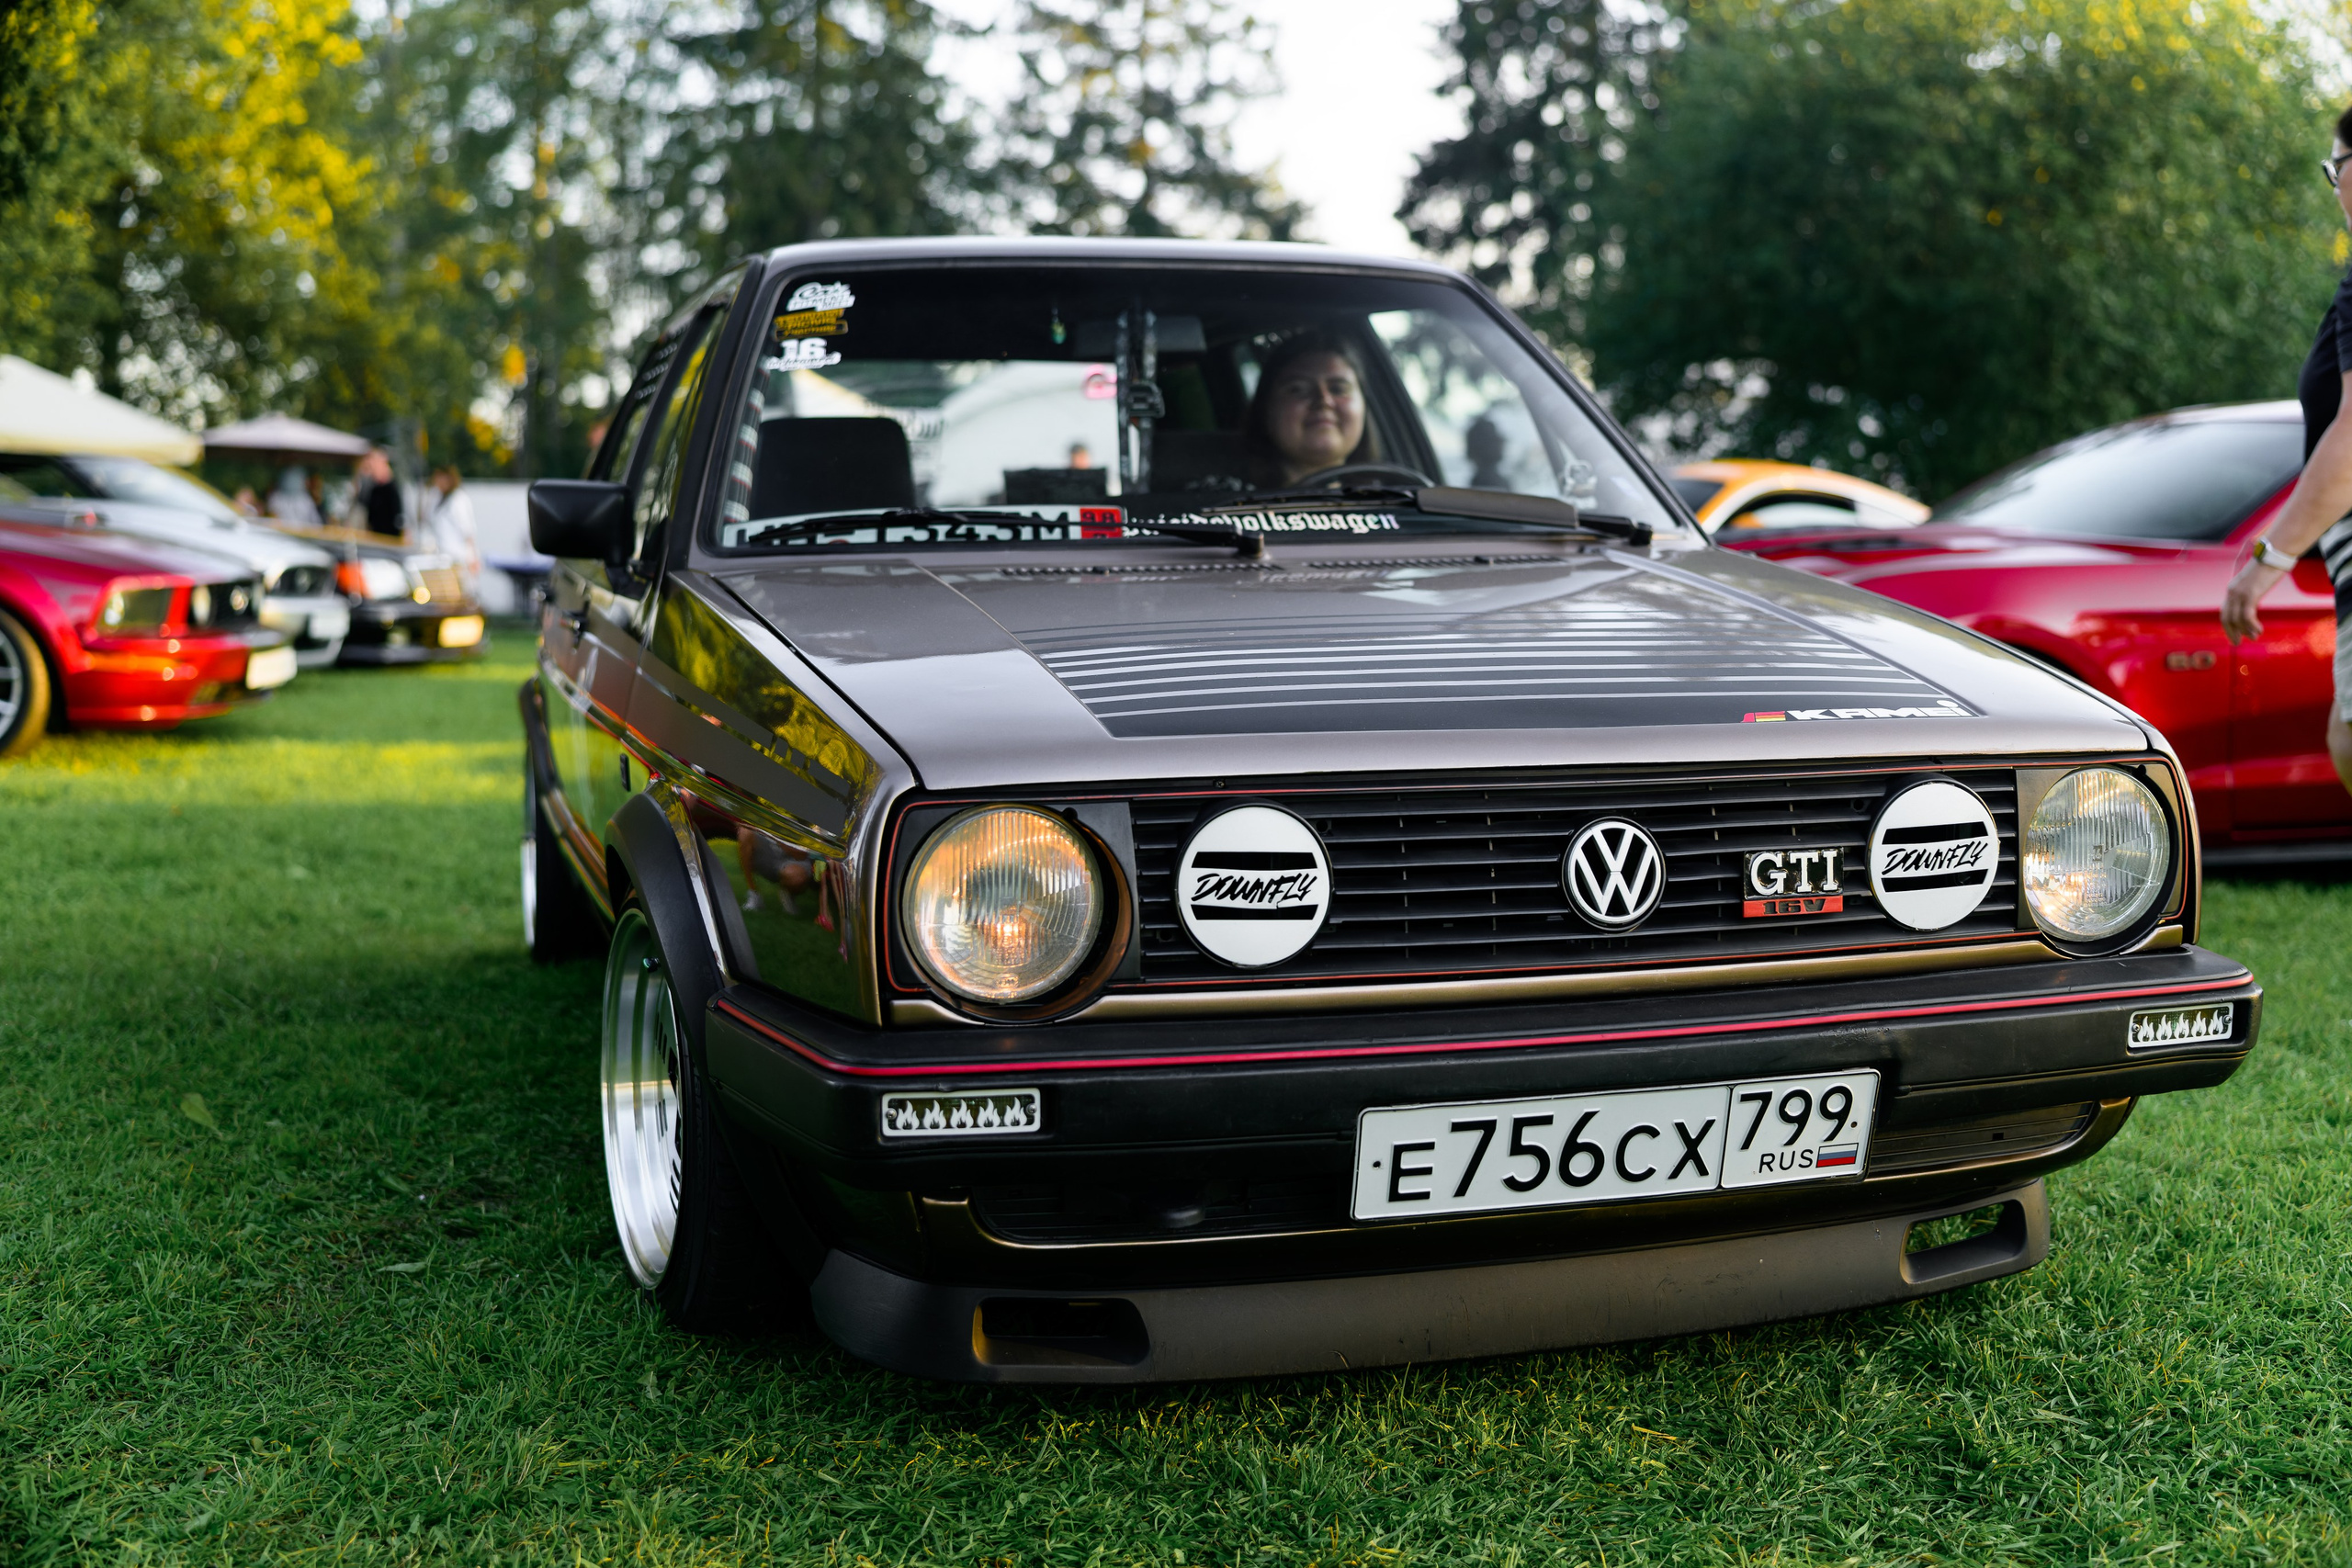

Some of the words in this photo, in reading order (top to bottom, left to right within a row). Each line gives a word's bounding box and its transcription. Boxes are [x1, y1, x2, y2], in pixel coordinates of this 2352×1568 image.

[780, 338, 827, 360] 16
[1881, 840, 1988, 875] DOWNFLY
[1191, 873, 1317, 903] DOWNFLY
[1750, 850, 1838, 896] GTI
[1763, 898, 1826, 915] 16V
[1387, 1110, 1716, 1202] E756CX
[1739, 1085, 1853, 1151] 799
[1758, 1149, 1814, 1174] RUS
